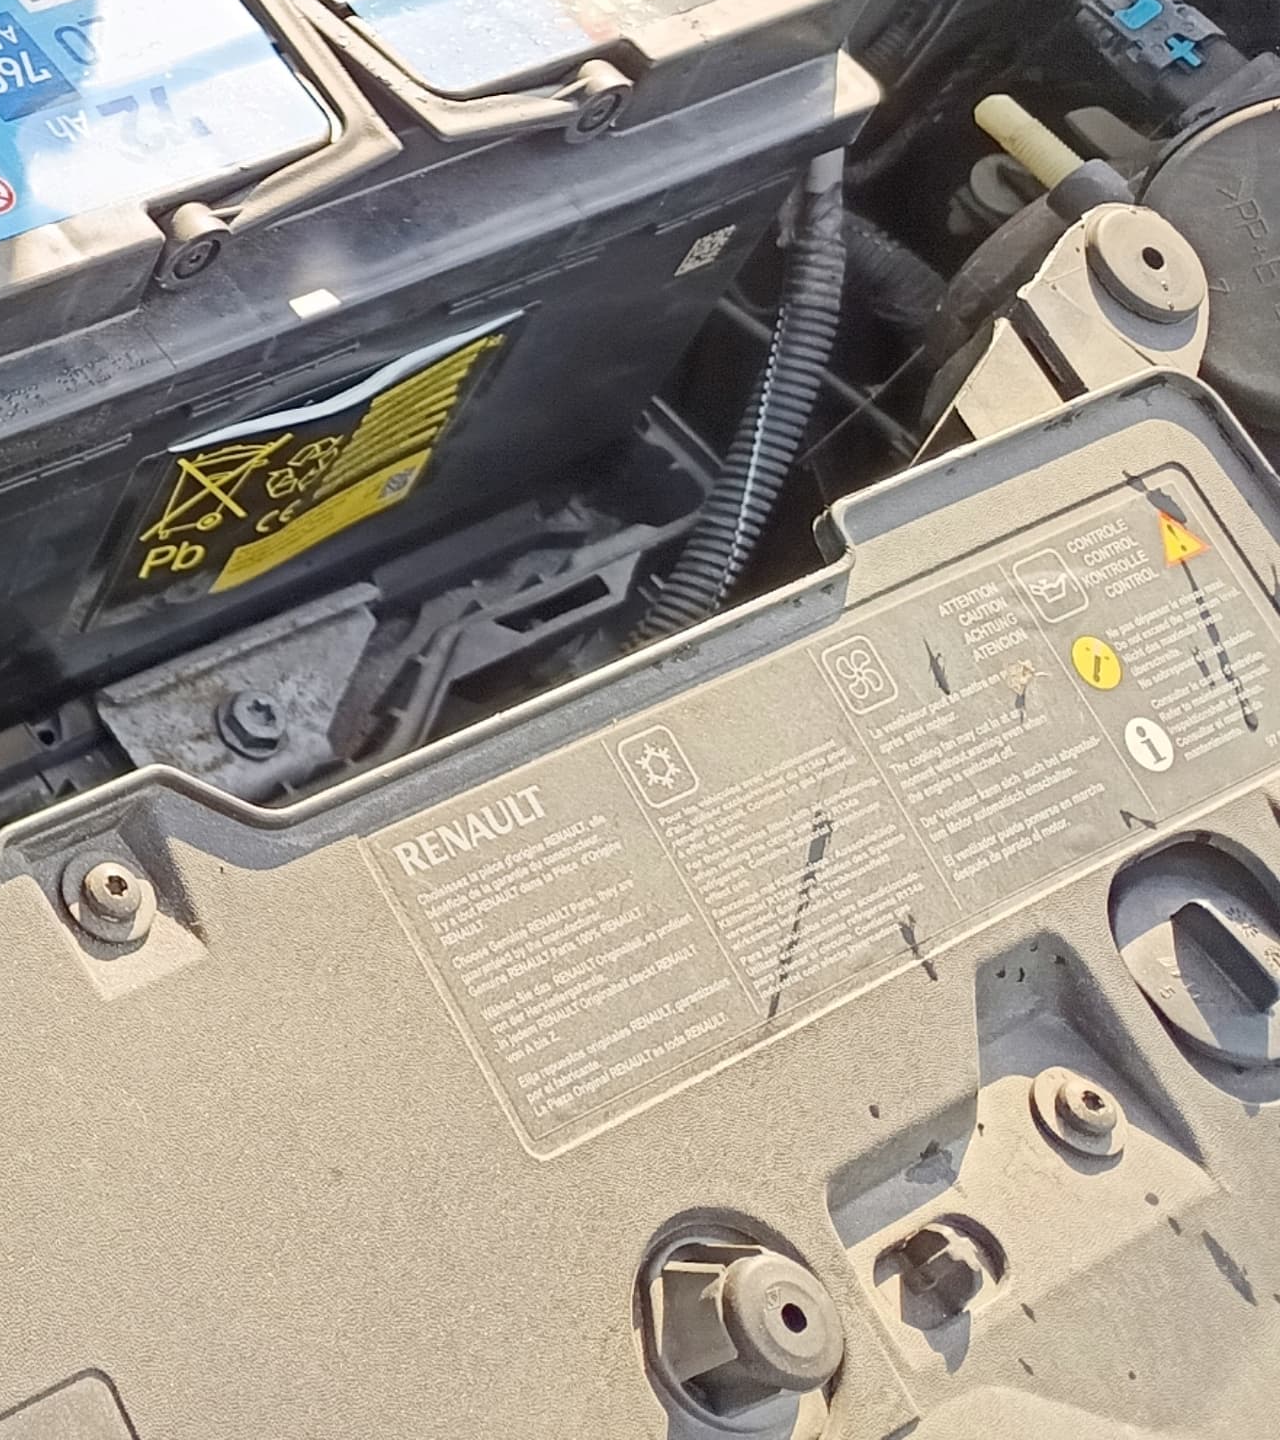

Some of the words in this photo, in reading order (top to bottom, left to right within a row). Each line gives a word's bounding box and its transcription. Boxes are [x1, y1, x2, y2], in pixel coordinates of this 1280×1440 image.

[42, 108, 101, 145] Ah
[1066, 518, 1127, 553] CONTROLE
[1083, 535, 1139, 566] CONTROL
[137, 539, 207, 579] Pb
[1080, 549, 1148, 587] KONTROLLE
[938, 581, 999, 616] ATTENTION
[1104, 566, 1159, 597] CONTROL
[958, 596, 1009, 626] CAUTION
[963, 611, 1017, 645] ACHTUNG
[972, 627, 1029, 662] ATENCION
[395, 786, 543, 875] RENAULT
[466, 871, 479, 883] la
[451, 946, 489, 969] Choose
[487, 928, 528, 952] Genuine
[526, 905, 570, 933] RENAULT
[595, 884, 619, 901] they
[616, 878, 634, 892] are
